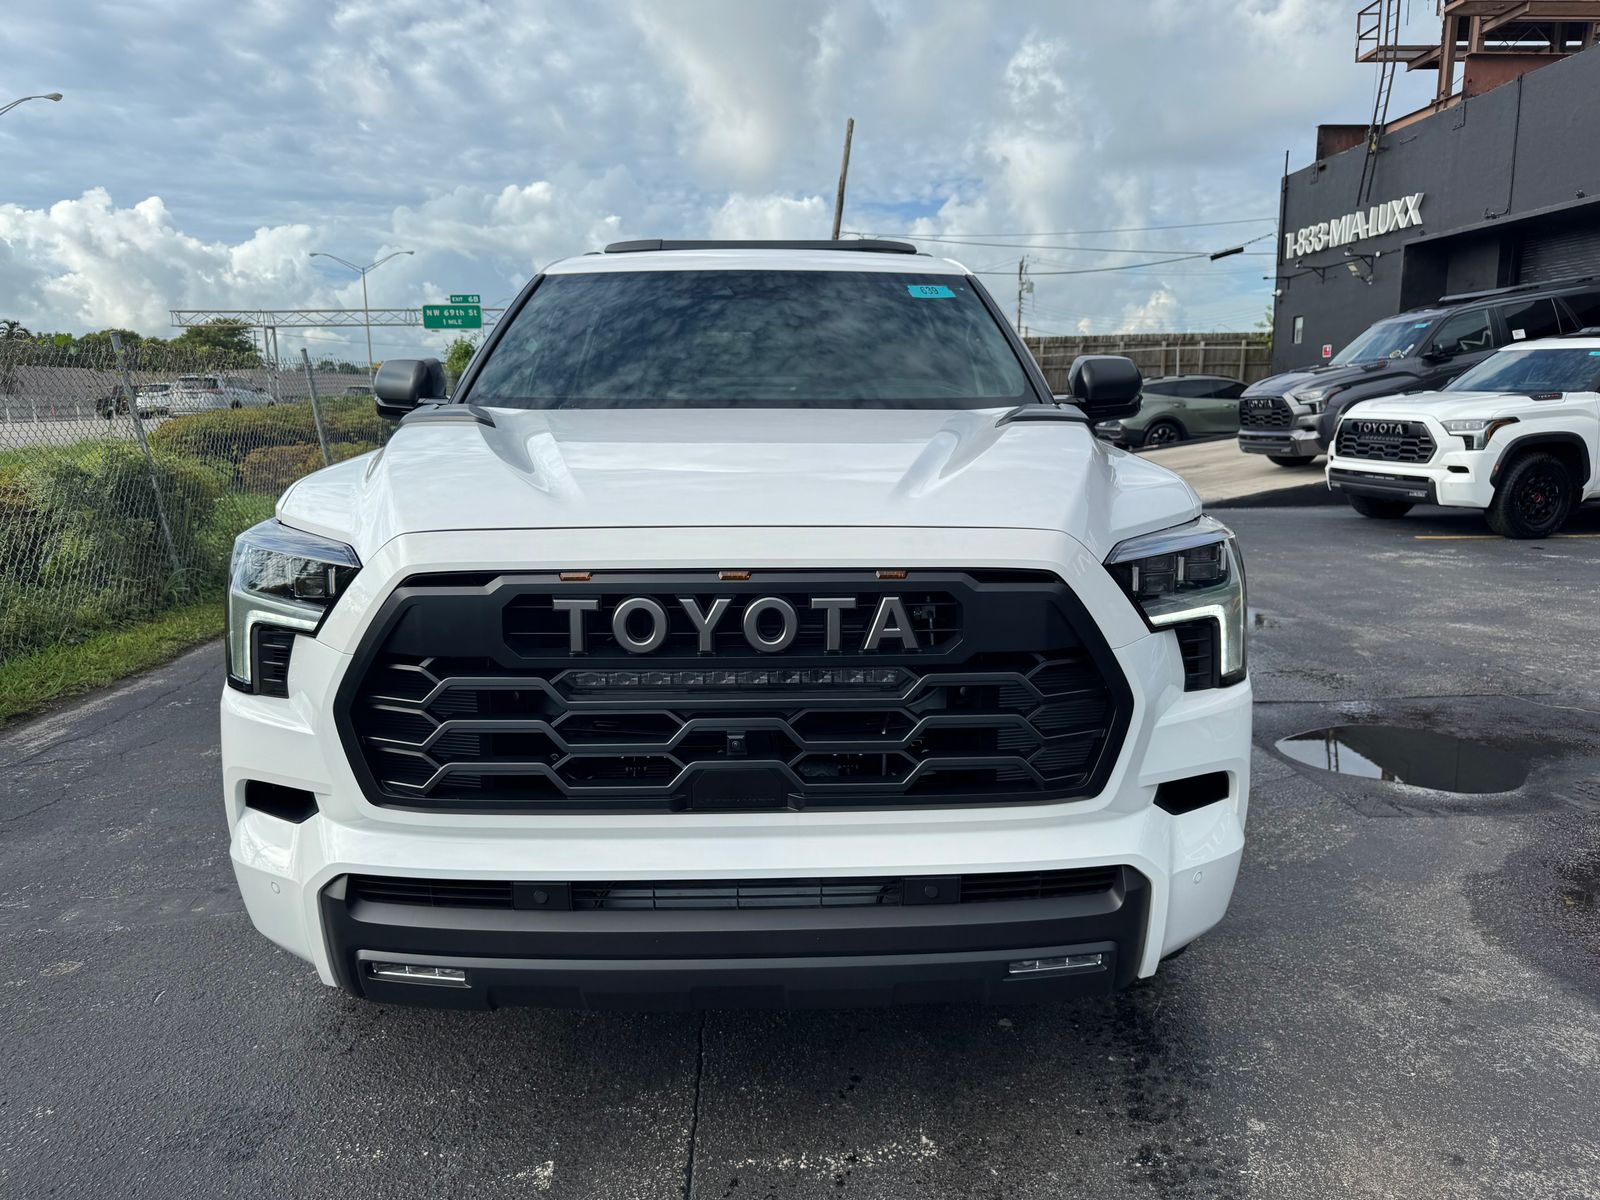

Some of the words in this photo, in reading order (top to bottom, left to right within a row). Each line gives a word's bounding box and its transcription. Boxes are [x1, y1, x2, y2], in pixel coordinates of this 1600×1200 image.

[426, 309, 440, 317] NW
[443, 309, 465, 317] 69th
[468, 309, 478, 317] St
[1357, 421, 1403, 435] TOYOTA
[551, 595, 920, 655] TOYOTA
